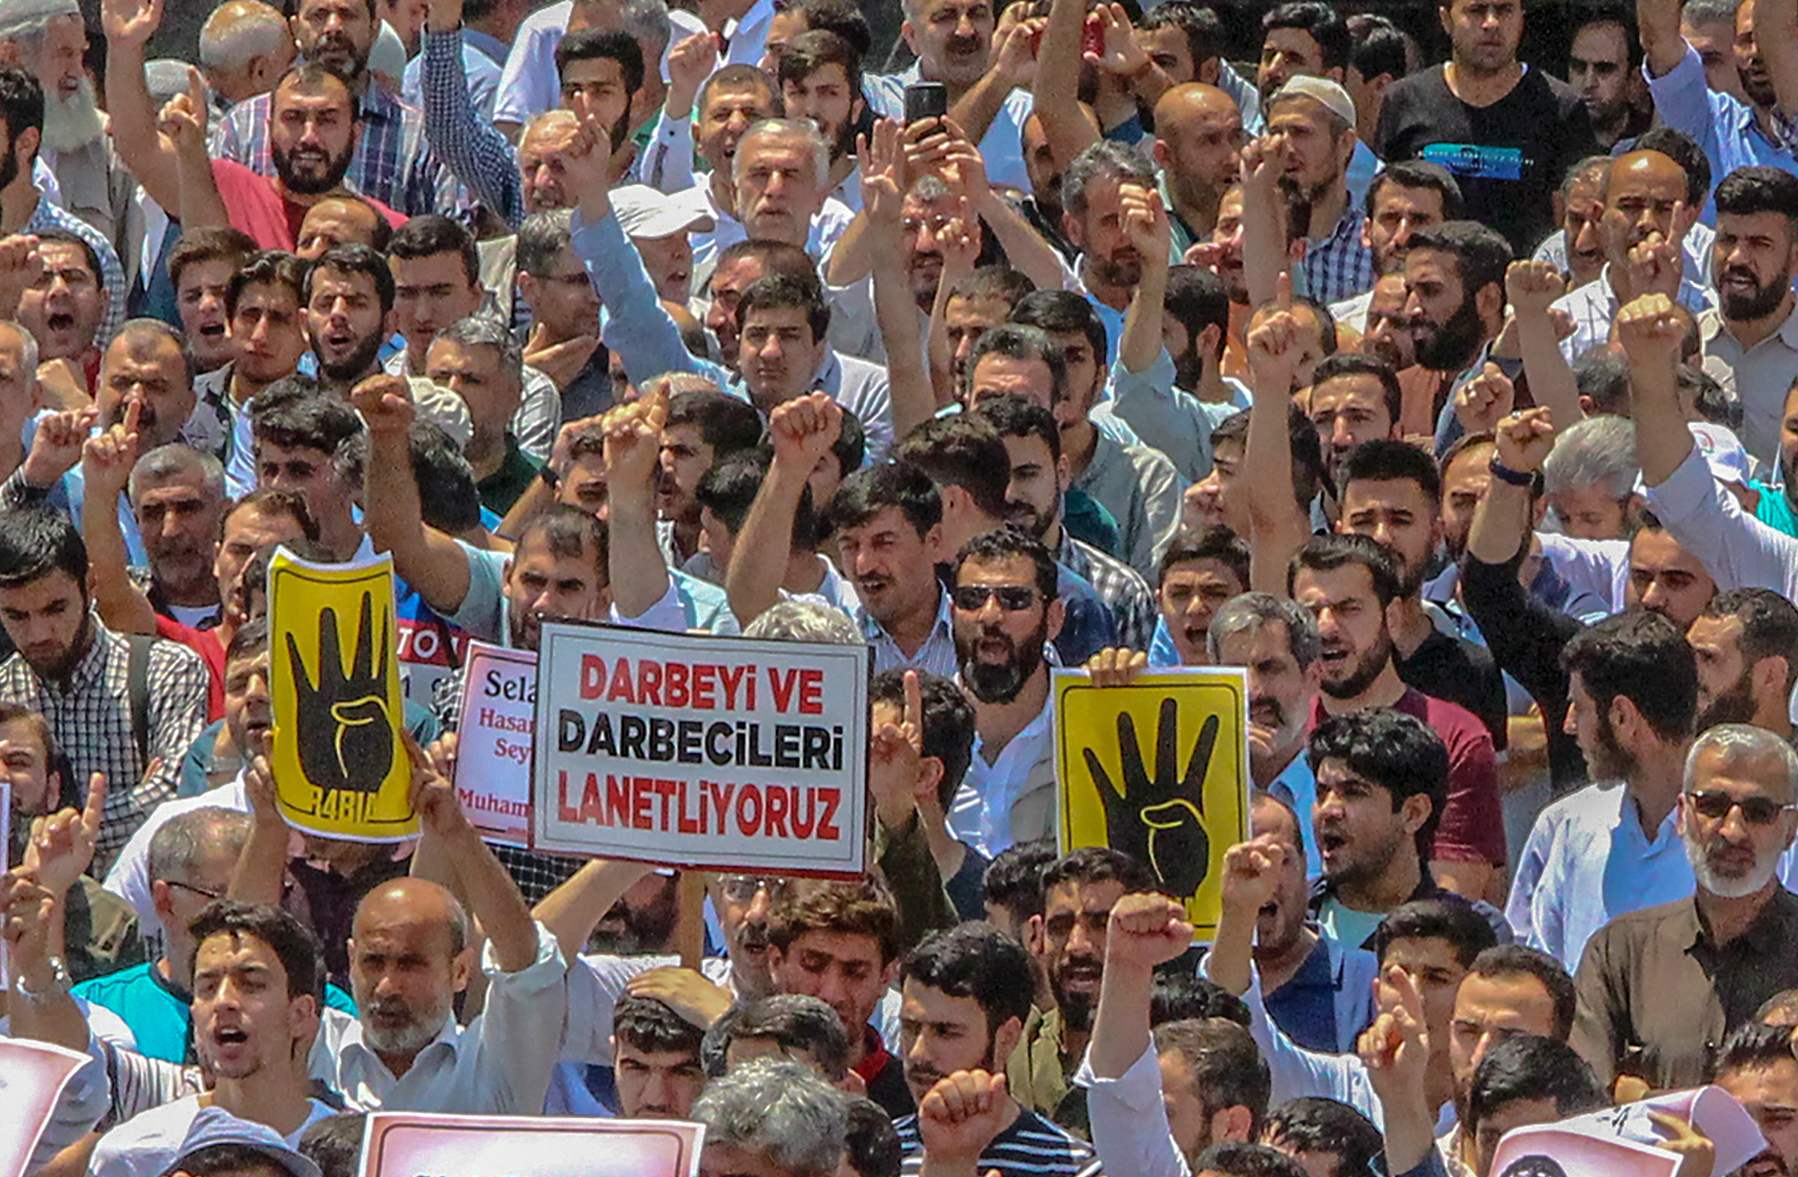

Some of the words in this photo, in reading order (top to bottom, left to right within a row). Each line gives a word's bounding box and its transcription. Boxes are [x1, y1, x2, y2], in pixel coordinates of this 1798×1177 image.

[579, 653, 757, 711] DARBEYİ
[767, 667, 824, 715] VE
[494, 737, 530, 764] Sey
[557, 708, 844, 771] DARBECİLERİ
[458, 787, 528, 817] Muham
[557, 770, 841, 841] LANETLİYORUZ
